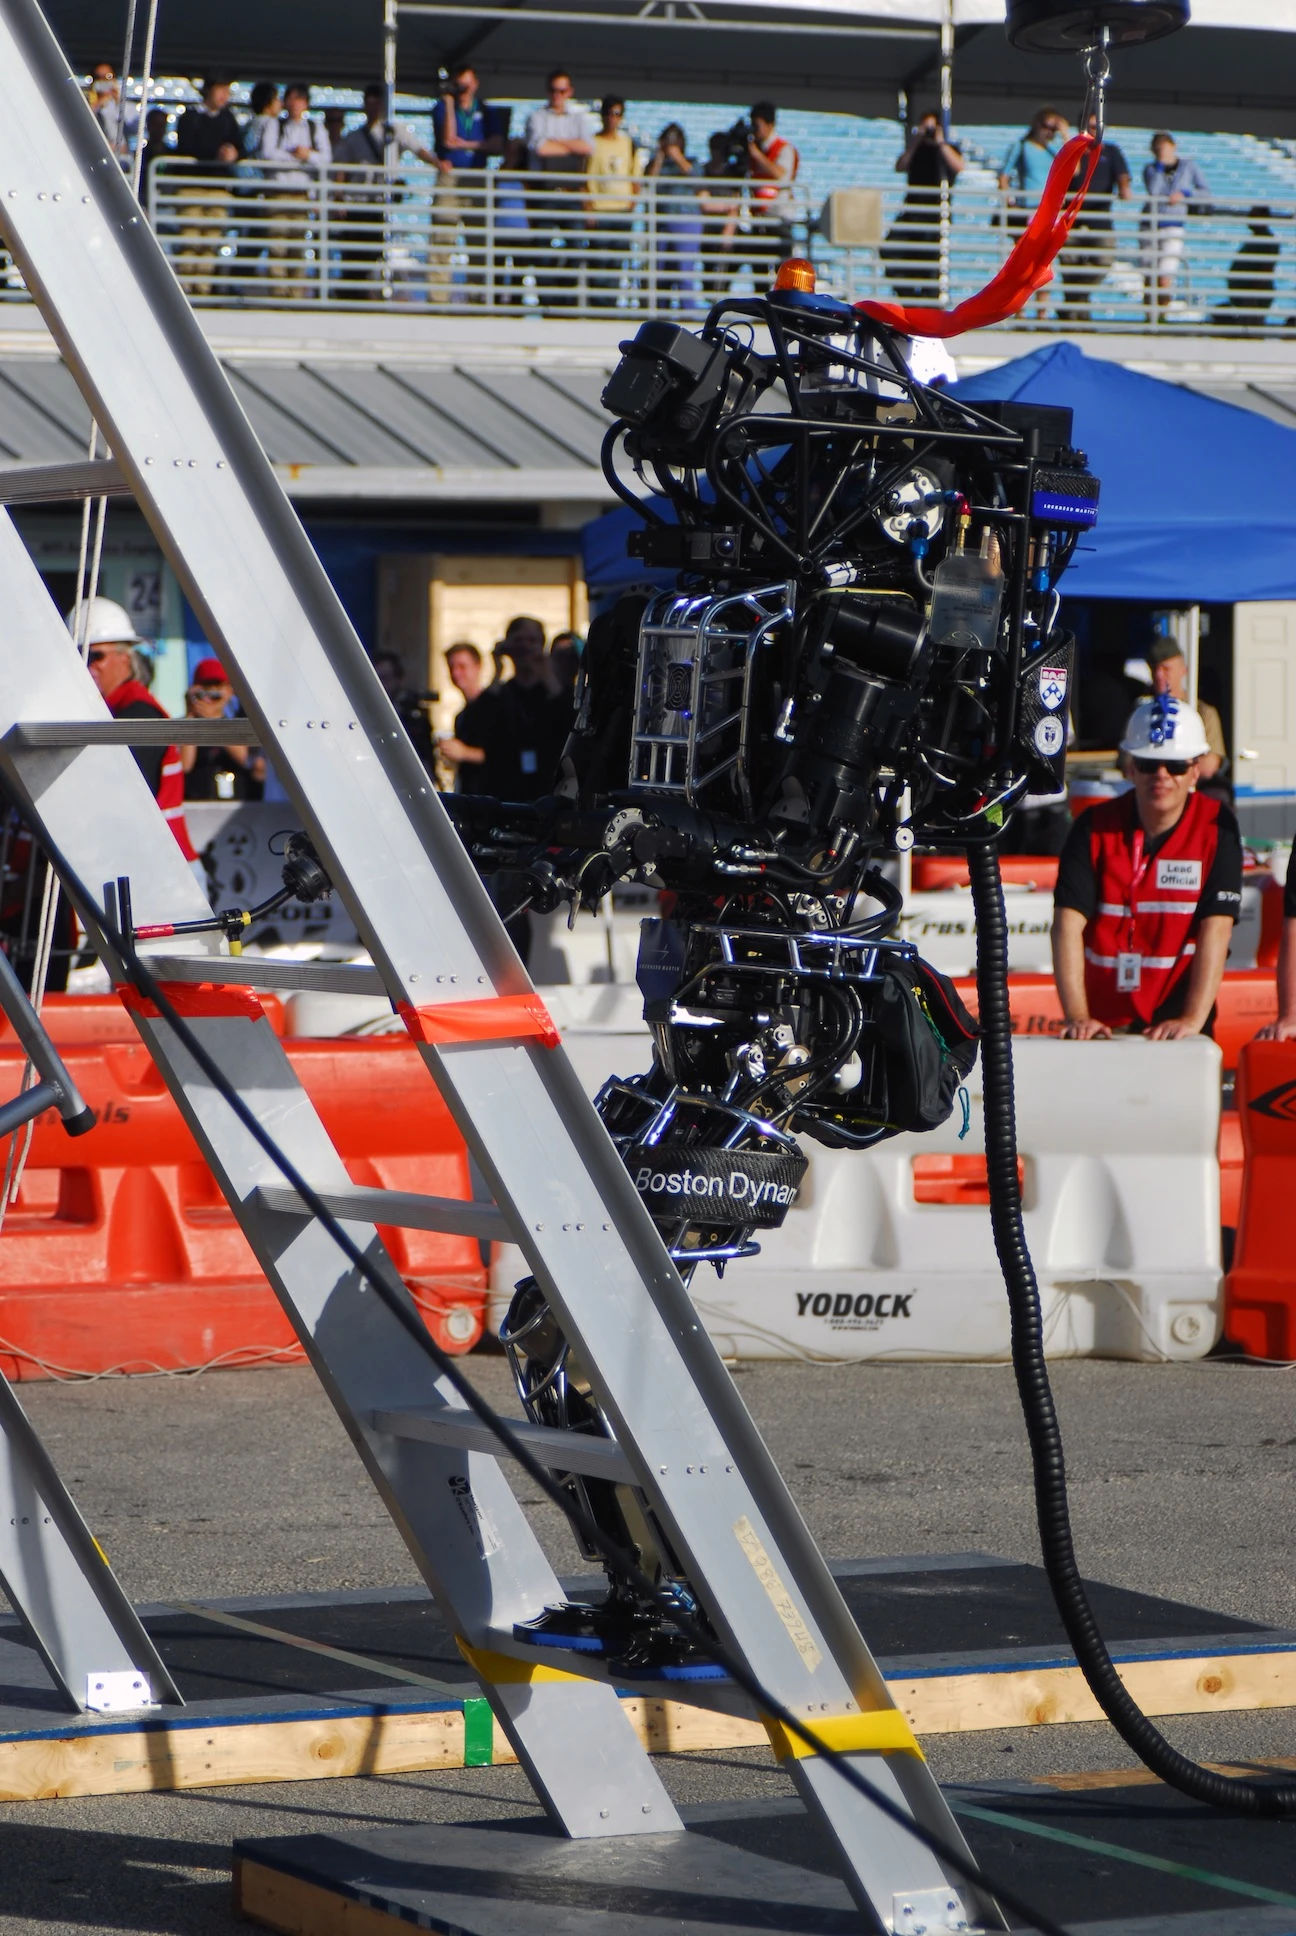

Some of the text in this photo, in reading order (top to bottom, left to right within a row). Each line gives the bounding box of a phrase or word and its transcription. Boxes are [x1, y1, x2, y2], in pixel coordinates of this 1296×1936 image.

[1167, 864, 1192, 873] Lead
[1160, 875, 1198, 885] Official
[635, 1167, 723, 1197] Boston
[796, 1293, 913, 1318] YODOCK
